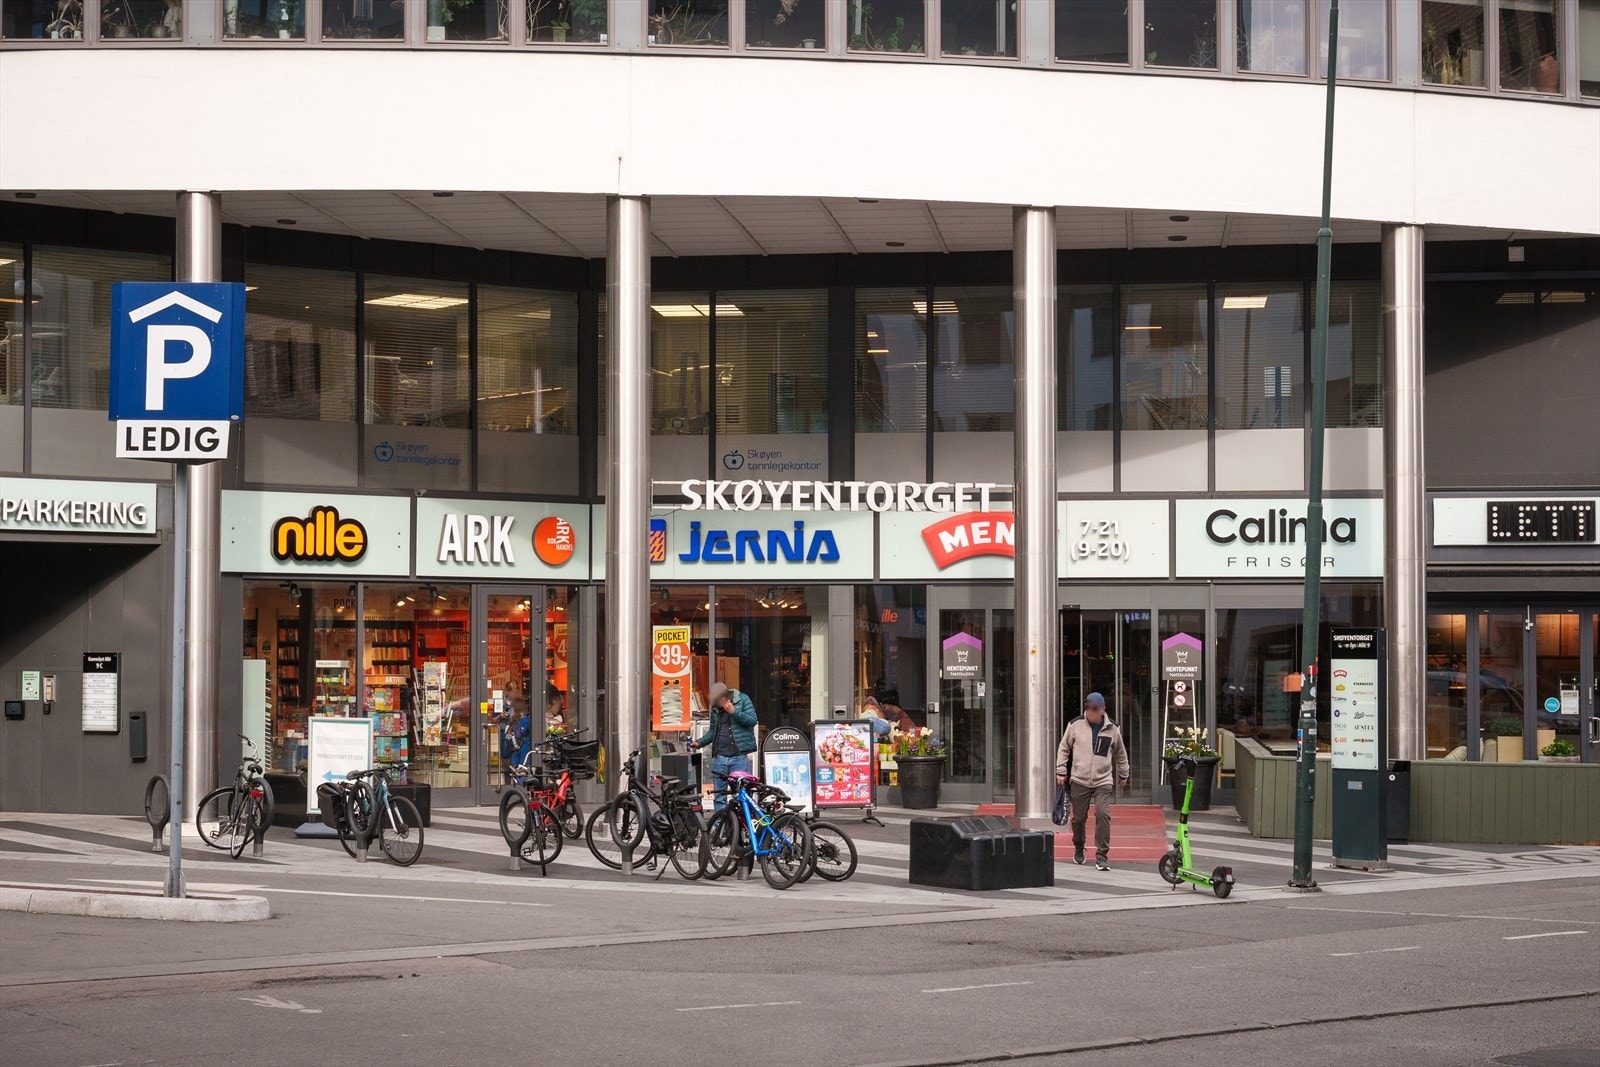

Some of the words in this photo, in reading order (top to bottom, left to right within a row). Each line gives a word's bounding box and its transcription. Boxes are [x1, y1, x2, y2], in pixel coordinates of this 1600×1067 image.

[145, 324, 212, 411] P
[125, 426, 220, 453] LEDIG
[747, 449, 783, 462] Skøyen
[747, 461, 822, 473] tannlegekontor
[681, 479, 996, 513] SKØYENTORGET
[1, 498, 147, 526] PARKERING
[1491, 505, 1592, 537] LETT
[275, 508, 365, 559] nille
[437, 513, 515, 563] ARK
[556, 517, 570, 544] ARK
[938, 521, 1015, 554] MEN
[1080, 519, 1119, 537] 7-21
[1205, 508, 1357, 544] Calima
[556, 543, 574, 551] HANDEL
[1070, 540, 1130, 562] (9-20)
[450, 634, 469, 643] NYHET
[489, 634, 506, 643] YHET!
[557, 638, 567, 657] 4
[657, 631, 686, 641] POCKET
[450, 645, 469, 653] NYHET
[489, 645, 506, 653] YHET!
[450, 656, 469, 664] NYHET
[489, 656, 506, 664] YHET!
[660, 644, 688, 668] 99,-
